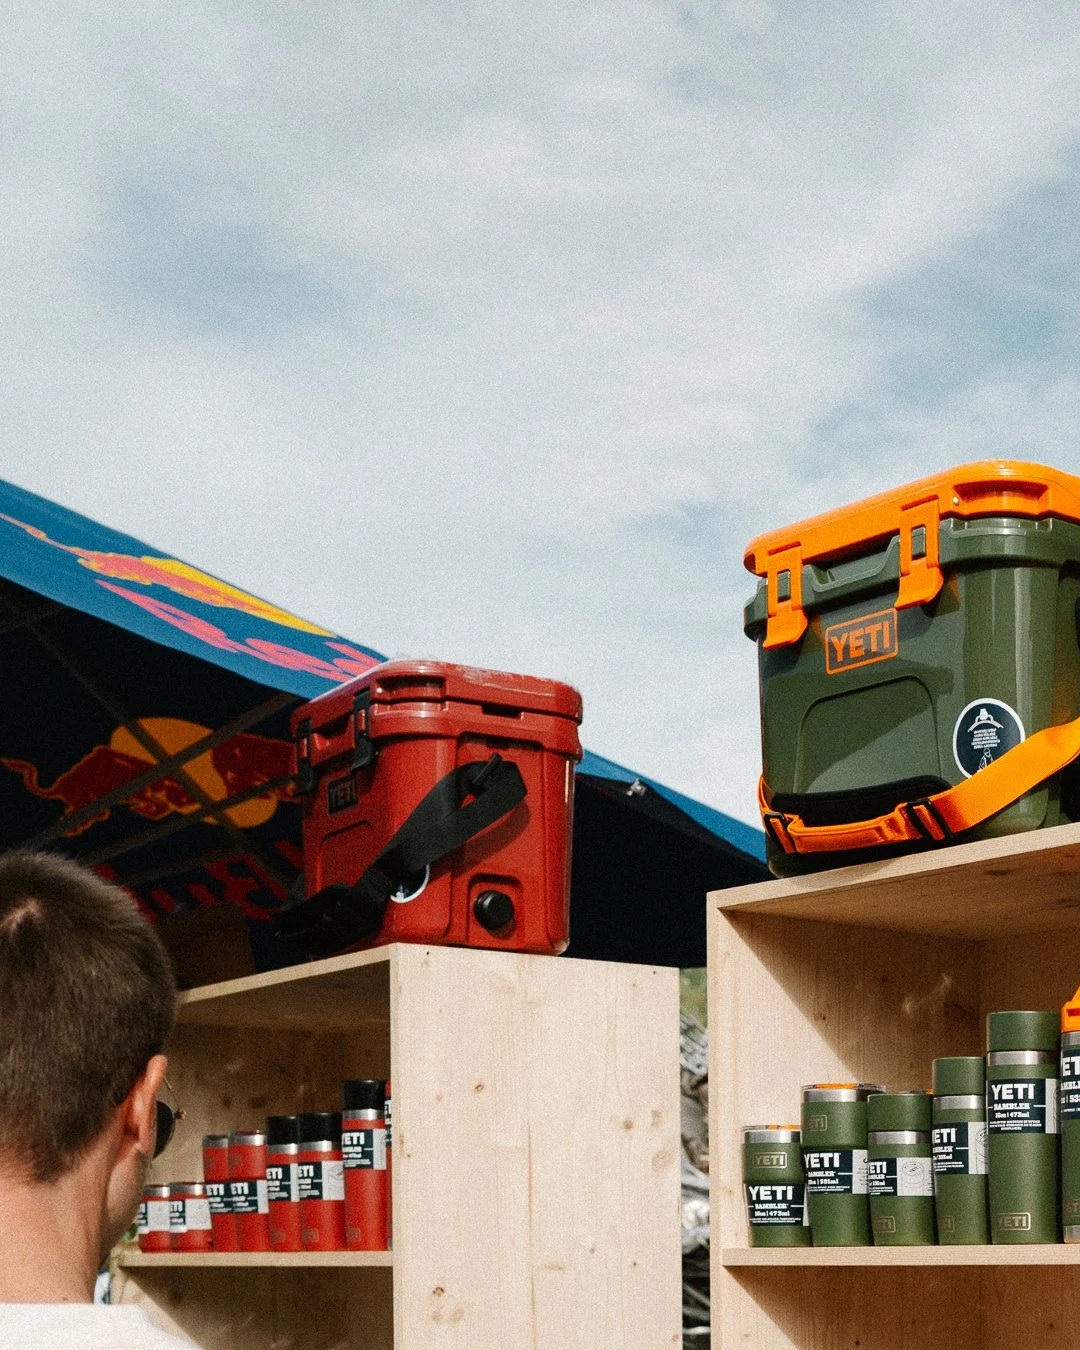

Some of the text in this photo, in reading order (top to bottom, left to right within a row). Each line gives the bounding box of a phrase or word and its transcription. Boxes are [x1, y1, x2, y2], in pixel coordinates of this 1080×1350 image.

[831, 621, 890, 662] YETI
[992, 1083, 1034, 1100] YETI
[933, 1128, 956, 1143] ETI
[755, 1155, 784, 1165] YETI
[804, 1153, 840, 1168] YETI
[749, 1186, 793, 1200] YETI
